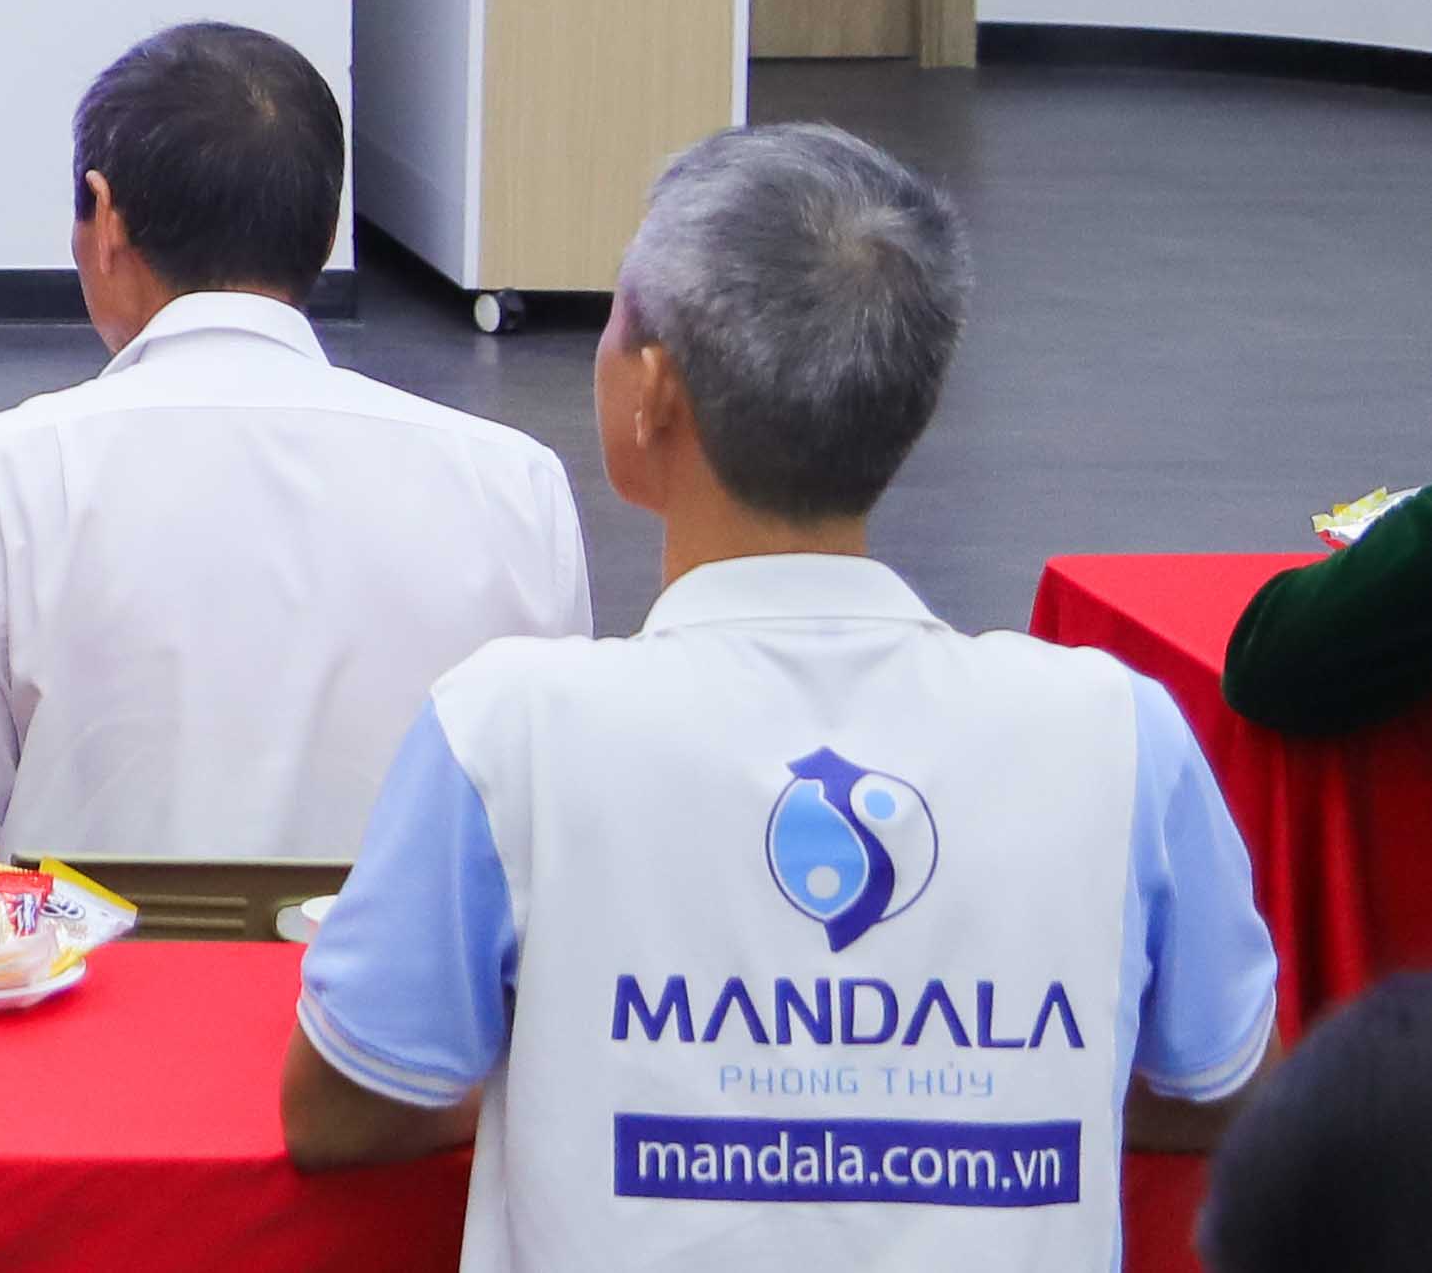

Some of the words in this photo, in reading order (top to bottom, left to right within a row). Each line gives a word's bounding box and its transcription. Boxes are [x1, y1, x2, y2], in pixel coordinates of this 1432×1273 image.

[611, 974, 1086, 1049] MANDALA
[720, 1064, 860, 1096] PHONG
[637, 1131, 1062, 1190] mandala.com.vn
